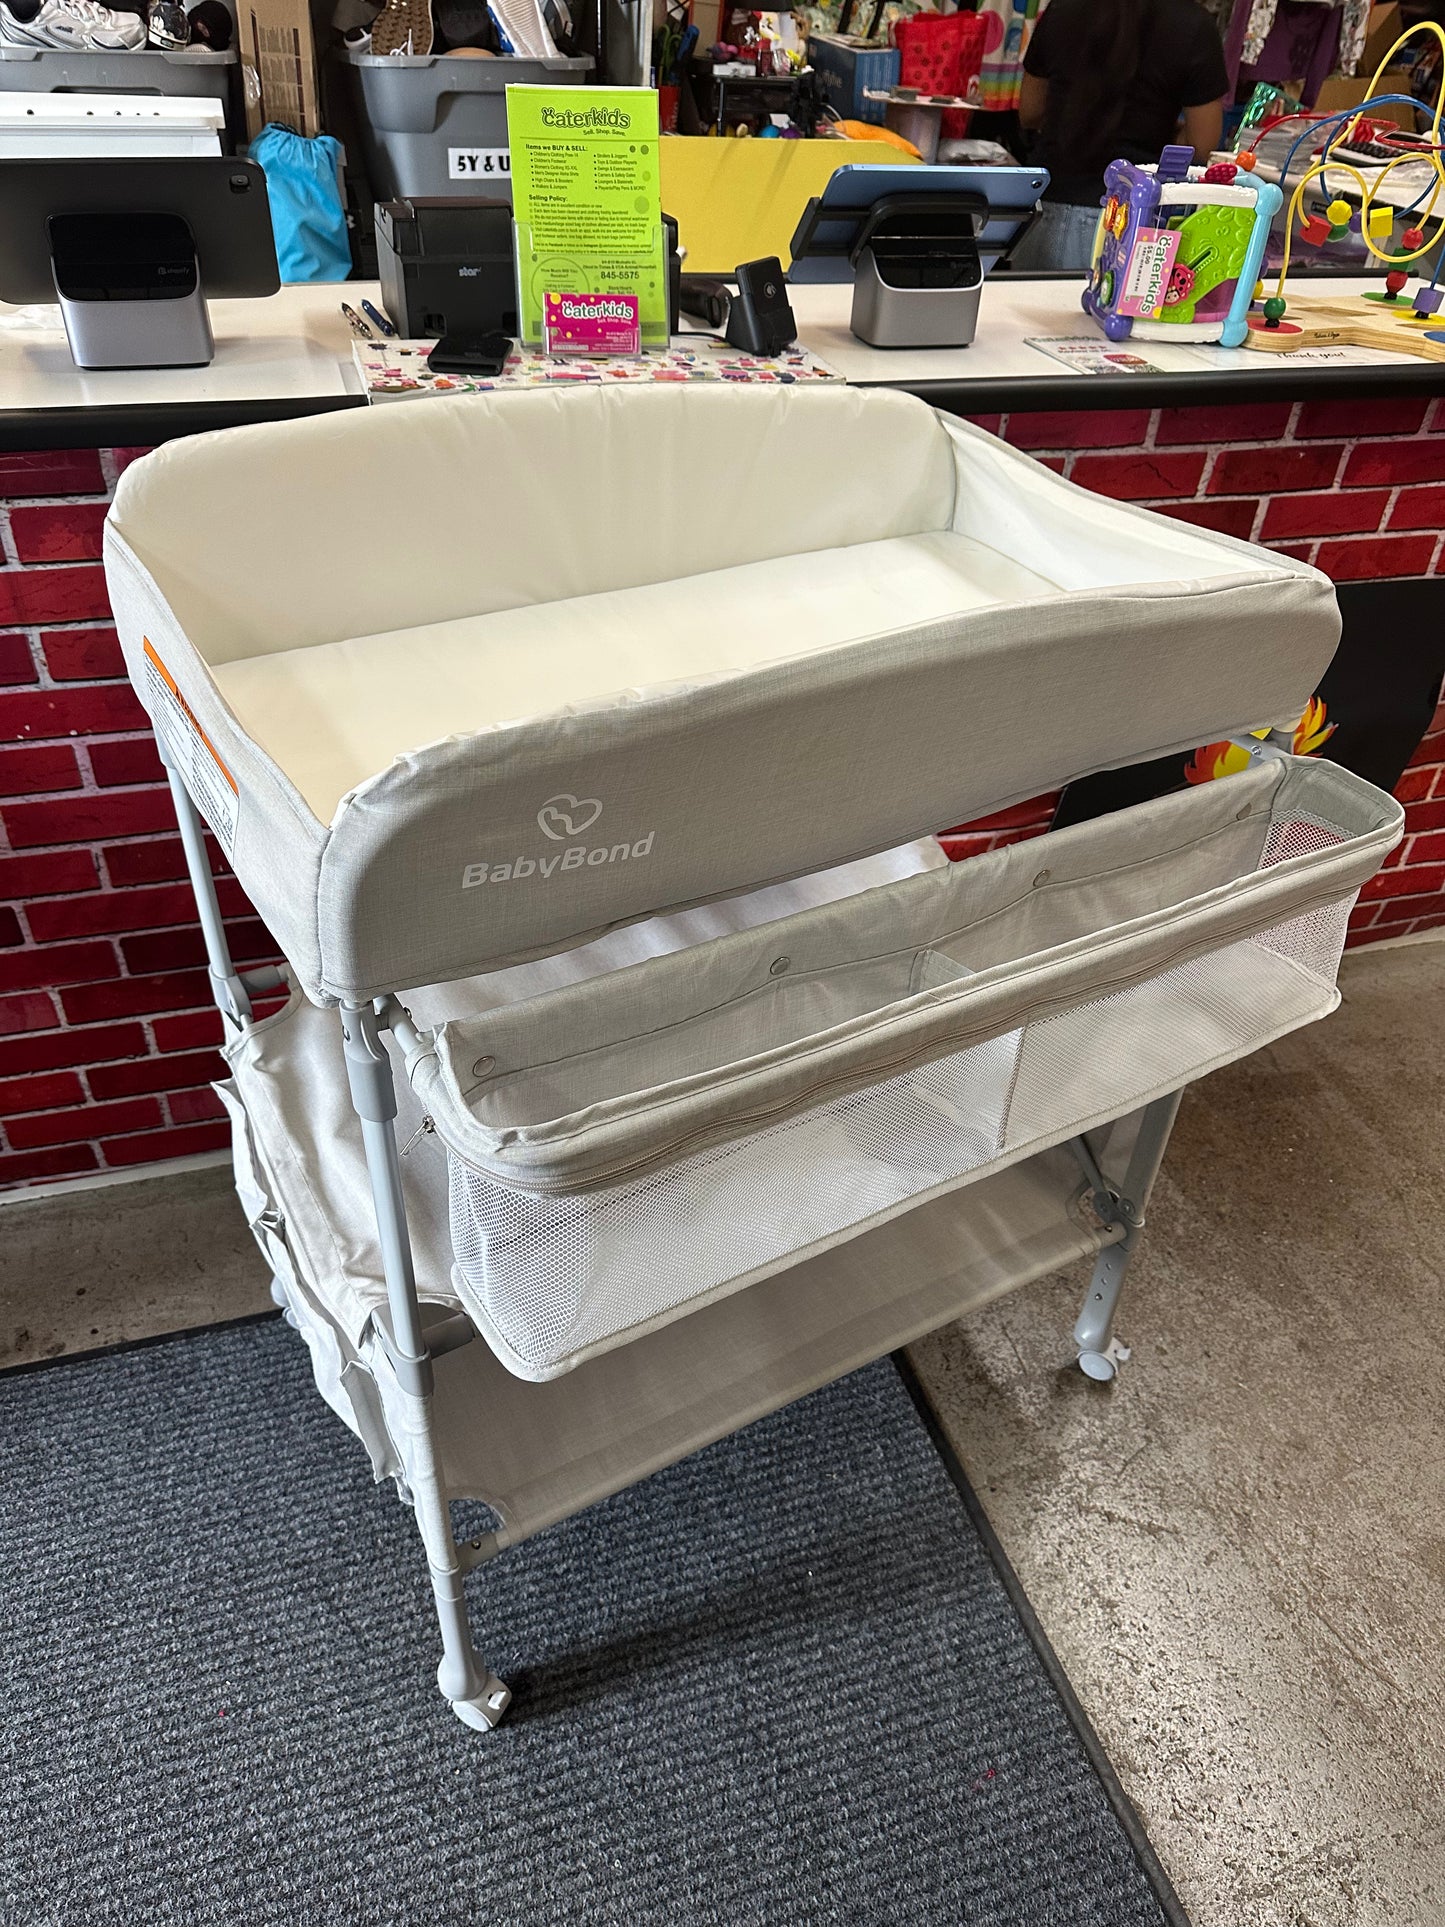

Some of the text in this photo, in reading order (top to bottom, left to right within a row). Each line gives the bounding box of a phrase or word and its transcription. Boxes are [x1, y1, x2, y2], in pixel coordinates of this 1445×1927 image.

[458, 155, 510, 172] 5Y & U
[458, 267, 479, 276] star
[600, 271, 639, 279] 845-5575
[462, 831, 655, 889] BabyBond
